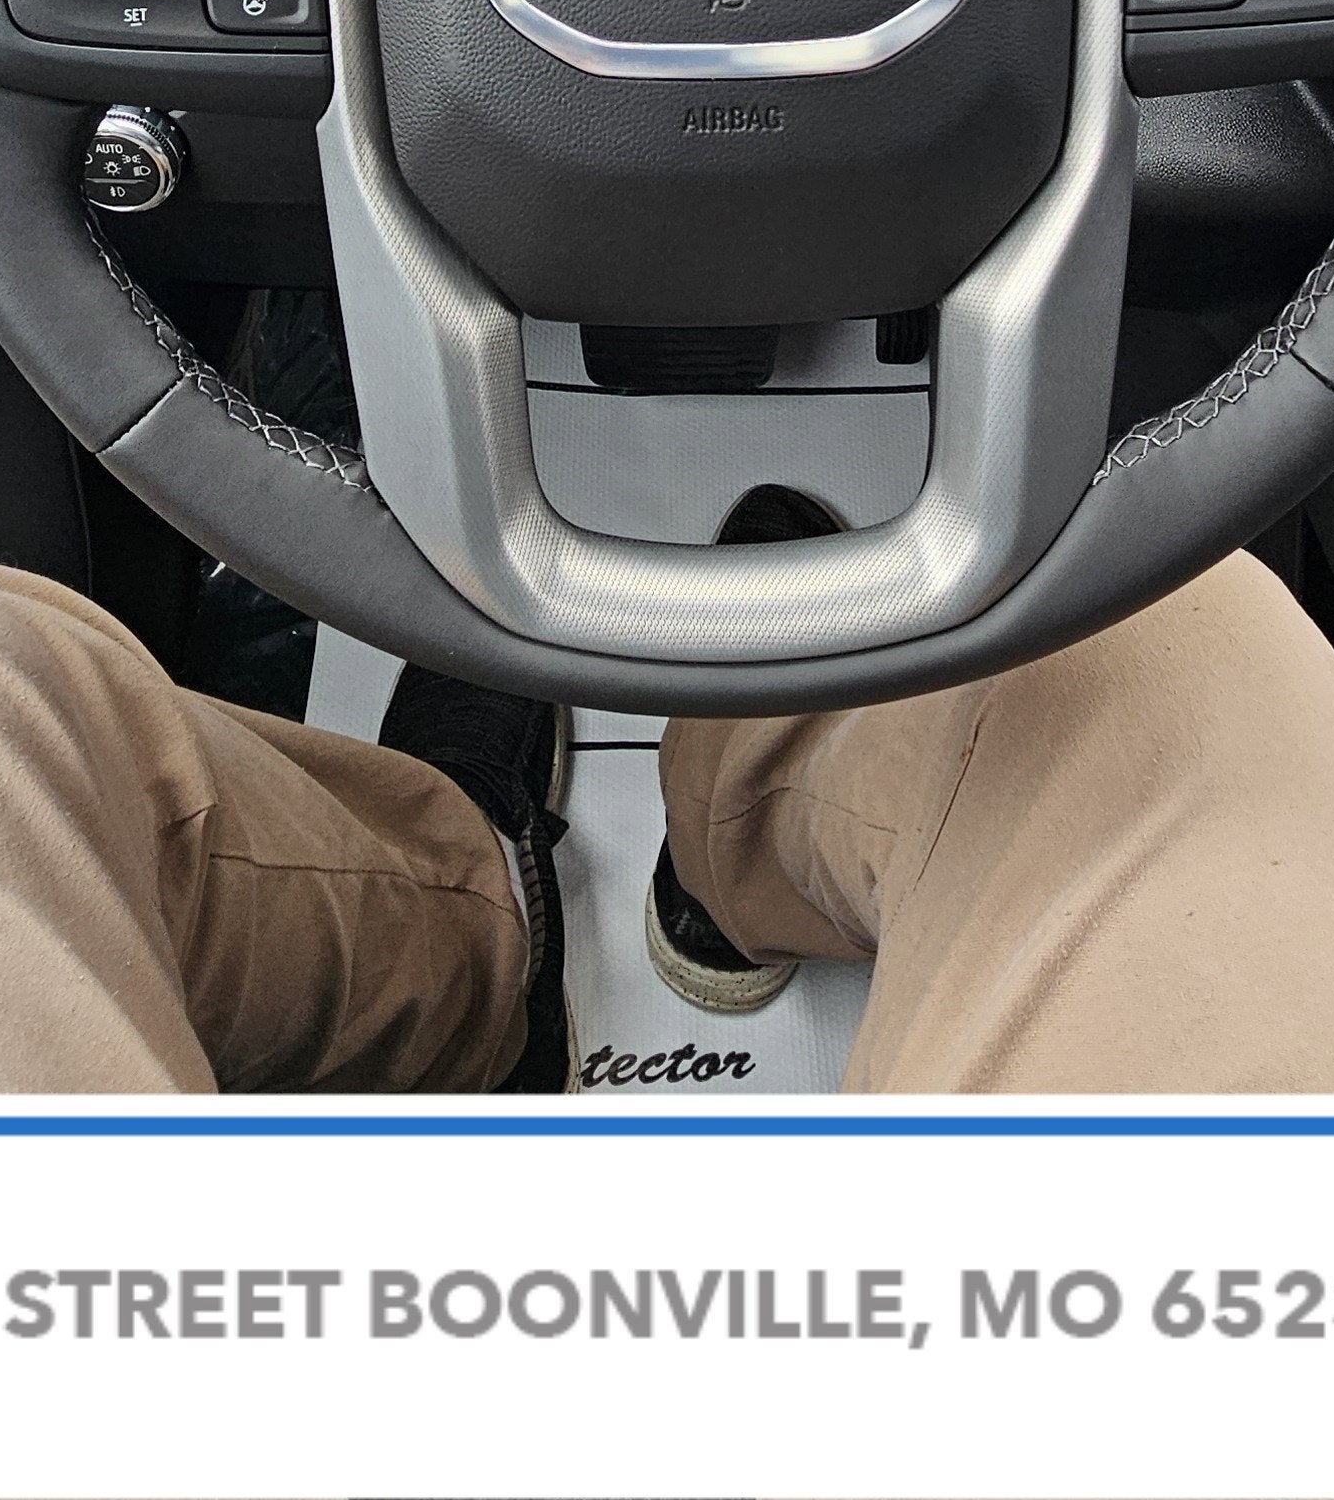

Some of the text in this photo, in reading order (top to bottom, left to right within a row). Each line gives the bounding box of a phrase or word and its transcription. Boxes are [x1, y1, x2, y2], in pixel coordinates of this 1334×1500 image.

[123, 7, 148, 23] SET
[680, 105, 786, 135] AIRBAG
[95, 143, 124, 154] AUTO
